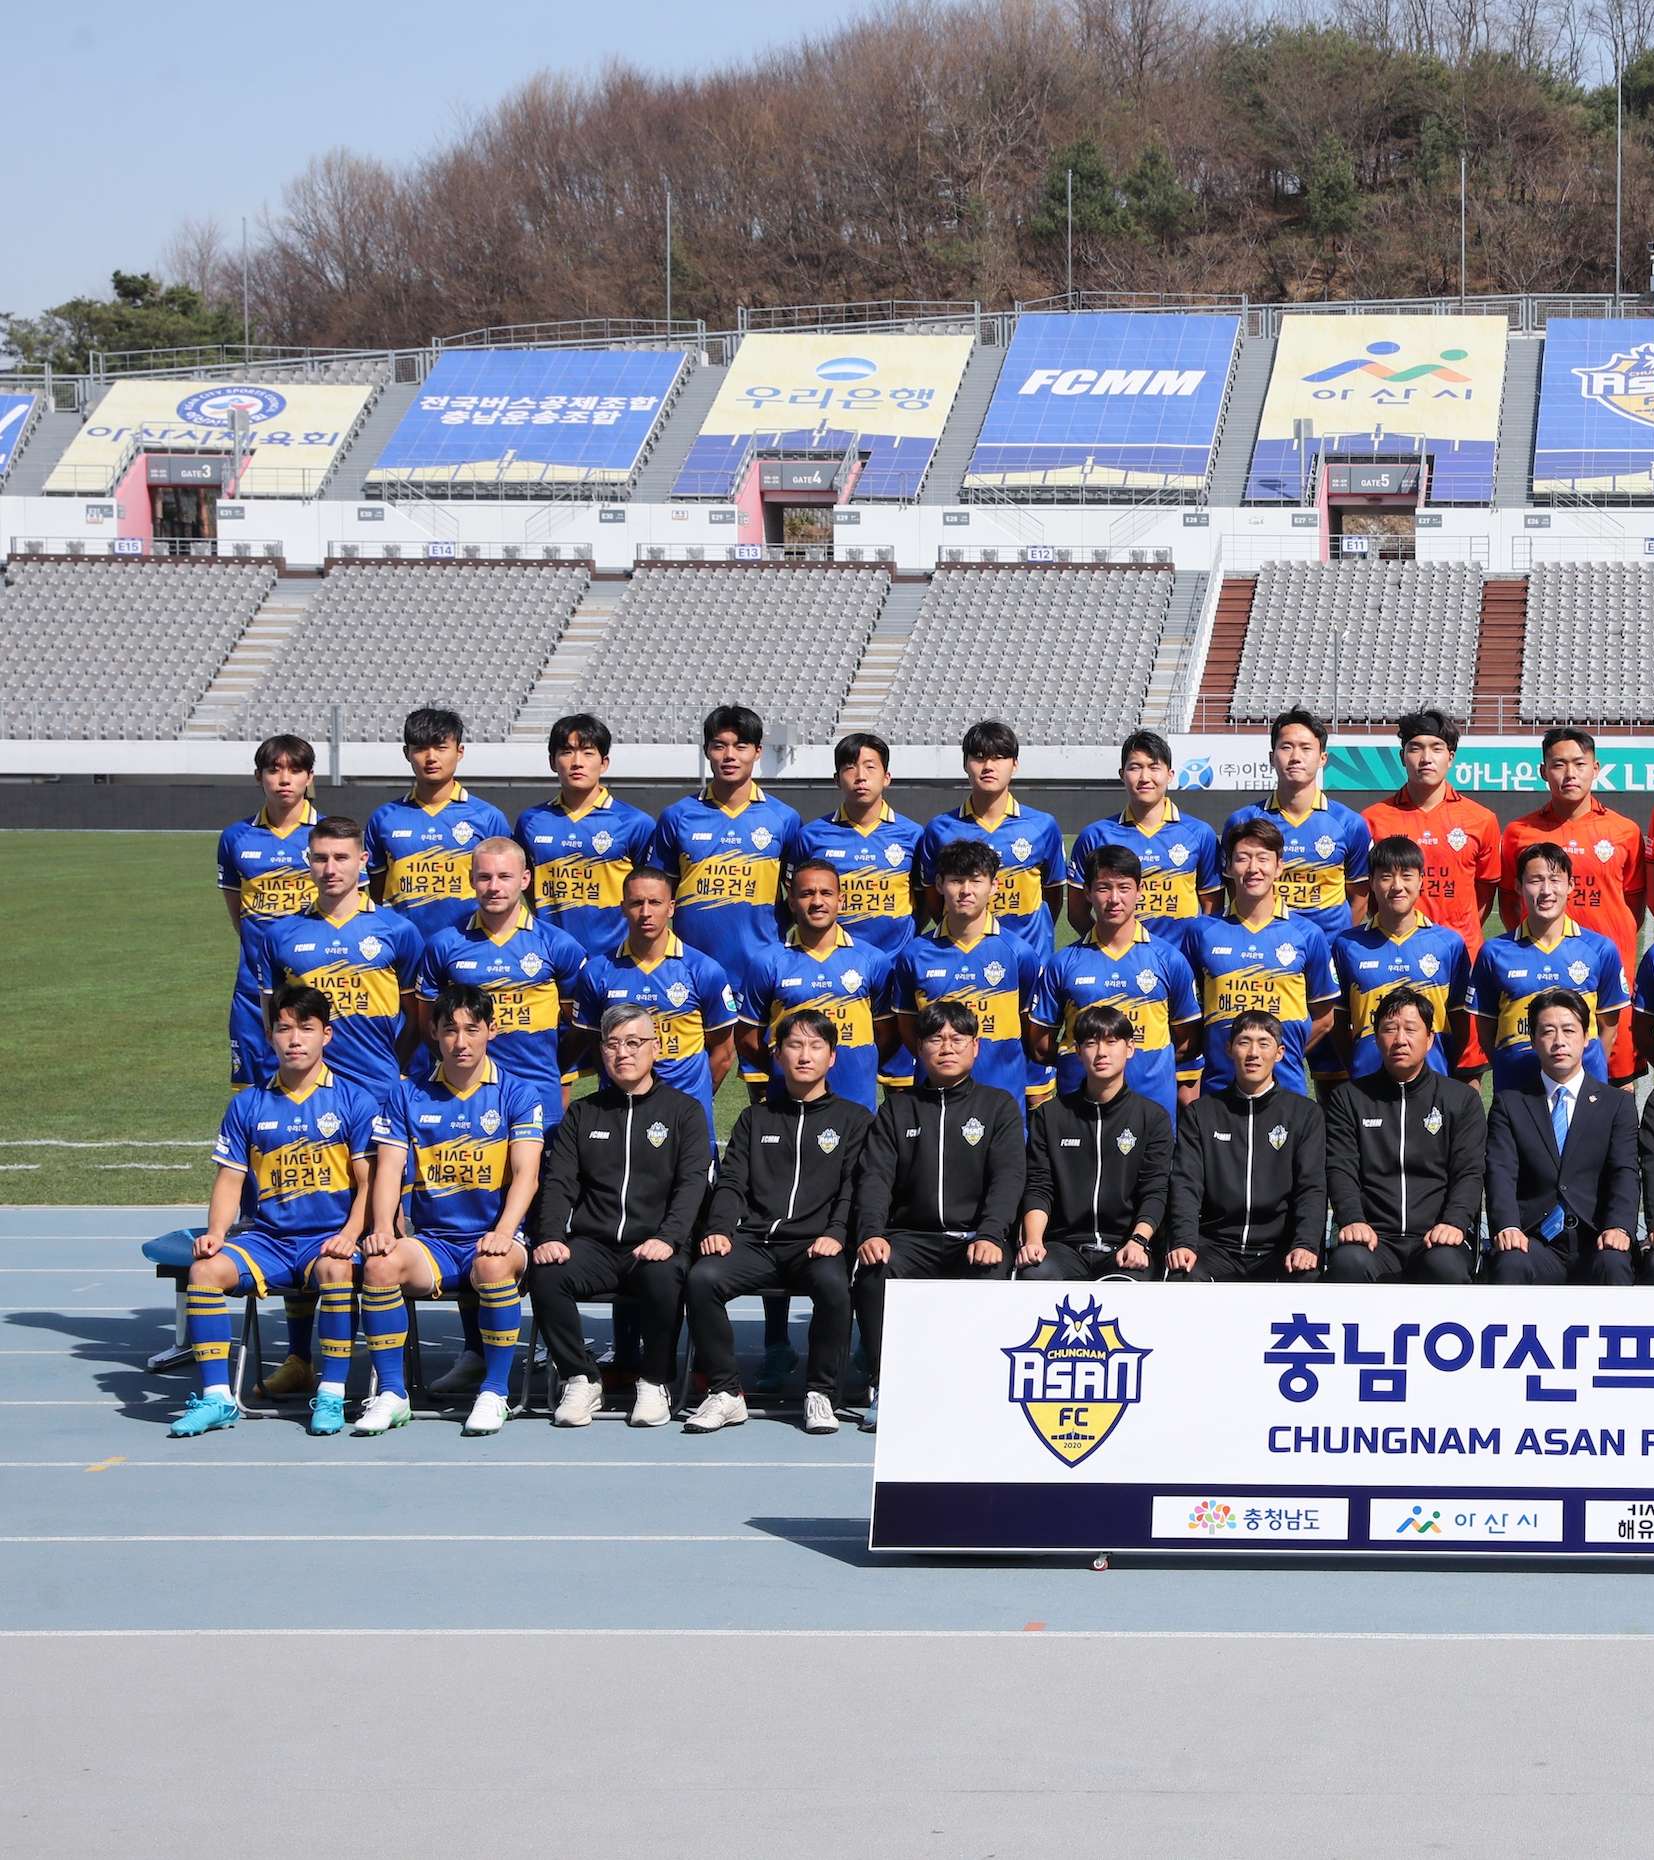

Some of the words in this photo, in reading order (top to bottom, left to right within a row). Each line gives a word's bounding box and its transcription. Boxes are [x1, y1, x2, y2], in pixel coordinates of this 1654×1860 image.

[1017, 368, 1207, 396] FCMM
[736, 386, 936, 411] 우리은행
[1312, 388, 1473, 405] 아산시
[181, 470, 202, 478] GATE
[202, 464, 212, 479] 3
[792, 476, 812, 485] GATE
[812, 470, 823, 484] 4
[1361, 479, 1381, 487] GATE
[1380, 474, 1390, 487] 5
[118, 542, 139, 551] E15
[432, 544, 453, 555] E14
[739, 548, 758, 558] E13
[1031, 549, 1050, 560] E12
[1346, 540, 1365, 551] E11
[1455, 762, 1547, 791] 하나은
[400, 875, 462, 894] 해유건설
[542, 880, 600, 900] 해유건설
[697, 877, 757, 898] 해유건설
[1219, 993, 1281, 1014] 해유건설
[270, 1166, 331, 1187] 해유건설
[427, 1163, 493, 1184] 해유건설
[1047, 1347, 1107, 1361] CHUNGNAM
[1012, 1352, 1141, 1401] ASAN
[1059, 1406, 1088, 1427] FC
[1267, 1425, 1501, 1455] CHUNGNAM
[1513, 1427, 1626, 1456] ASAN
[1243, 1508, 1321, 1531] 충청남도
[1455, 1513, 1538, 1534] 아산시
